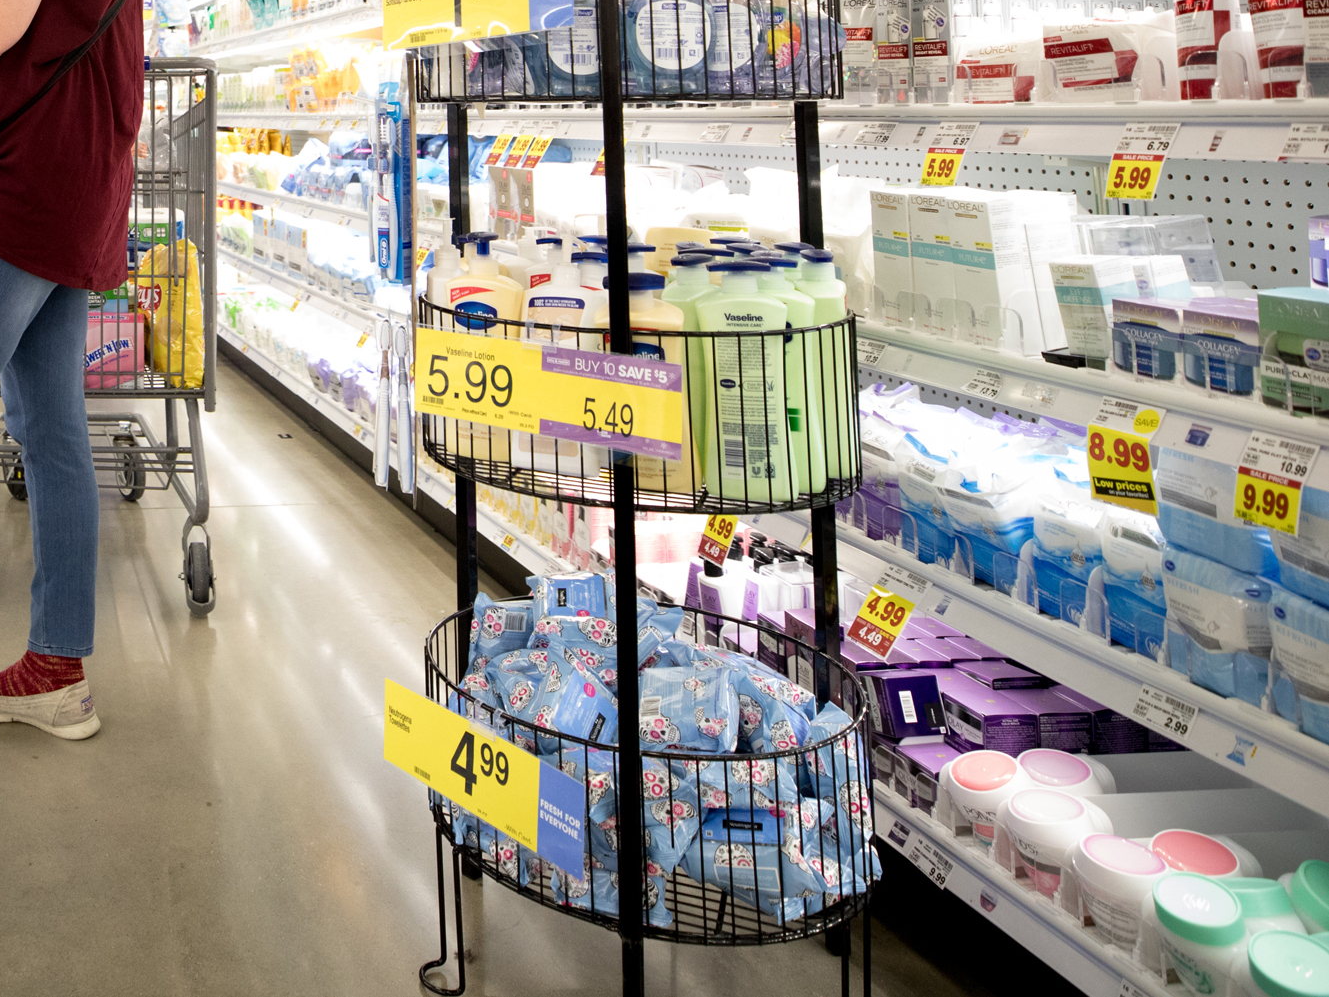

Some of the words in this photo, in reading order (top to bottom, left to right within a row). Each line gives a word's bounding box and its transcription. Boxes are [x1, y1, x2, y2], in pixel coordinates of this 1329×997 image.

[914, 42, 947, 51] REVITALIFT
[1051, 43, 1094, 56] REVITALIFT
[953, 137, 970, 146] 6.97
[1146, 141, 1169, 151] 6.79
[926, 158, 954, 178] 5.99
[1113, 166, 1151, 190] 5.99
[446, 346, 473, 359] Vaseline
[474, 350, 495, 362] Lotion
[575, 357, 600, 373] BUY
[603, 361, 615, 375] 10
[618, 365, 652, 382] SAVE
[654, 368, 668, 384] $5
[427, 354, 513, 408] 5.99
[583, 397, 634, 438] 5.49
[1134, 417, 1159, 428] SAVE!
[1089, 432, 1150, 472] 8.99
[1250, 469, 1268, 480] SALE
[1268, 474, 1289, 486] PRICE
[1280, 461, 1307, 477] 10.99
[1095, 478, 1115, 489] Low
[1115, 481, 1148, 493] prices
[1243, 483, 1289, 520] 9.99
[708, 514, 733, 539] 4.99
[704, 542, 720, 557] 4.49
[867, 595, 906, 627] 4.99
[859, 626, 882, 646] 4.49
[388, 705, 412, 725] Neutrogena
[388, 715, 410, 734] Towelettes
[948, 715, 964, 733] OLAY
[1164, 717, 1188, 735] 2.99
[450, 731, 477, 797] 4
[480, 743, 509, 786] 99
[540, 799, 563, 819] FRESH
[564, 813, 581, 830] FOR
[929, 867, 946, 885] 9.99
